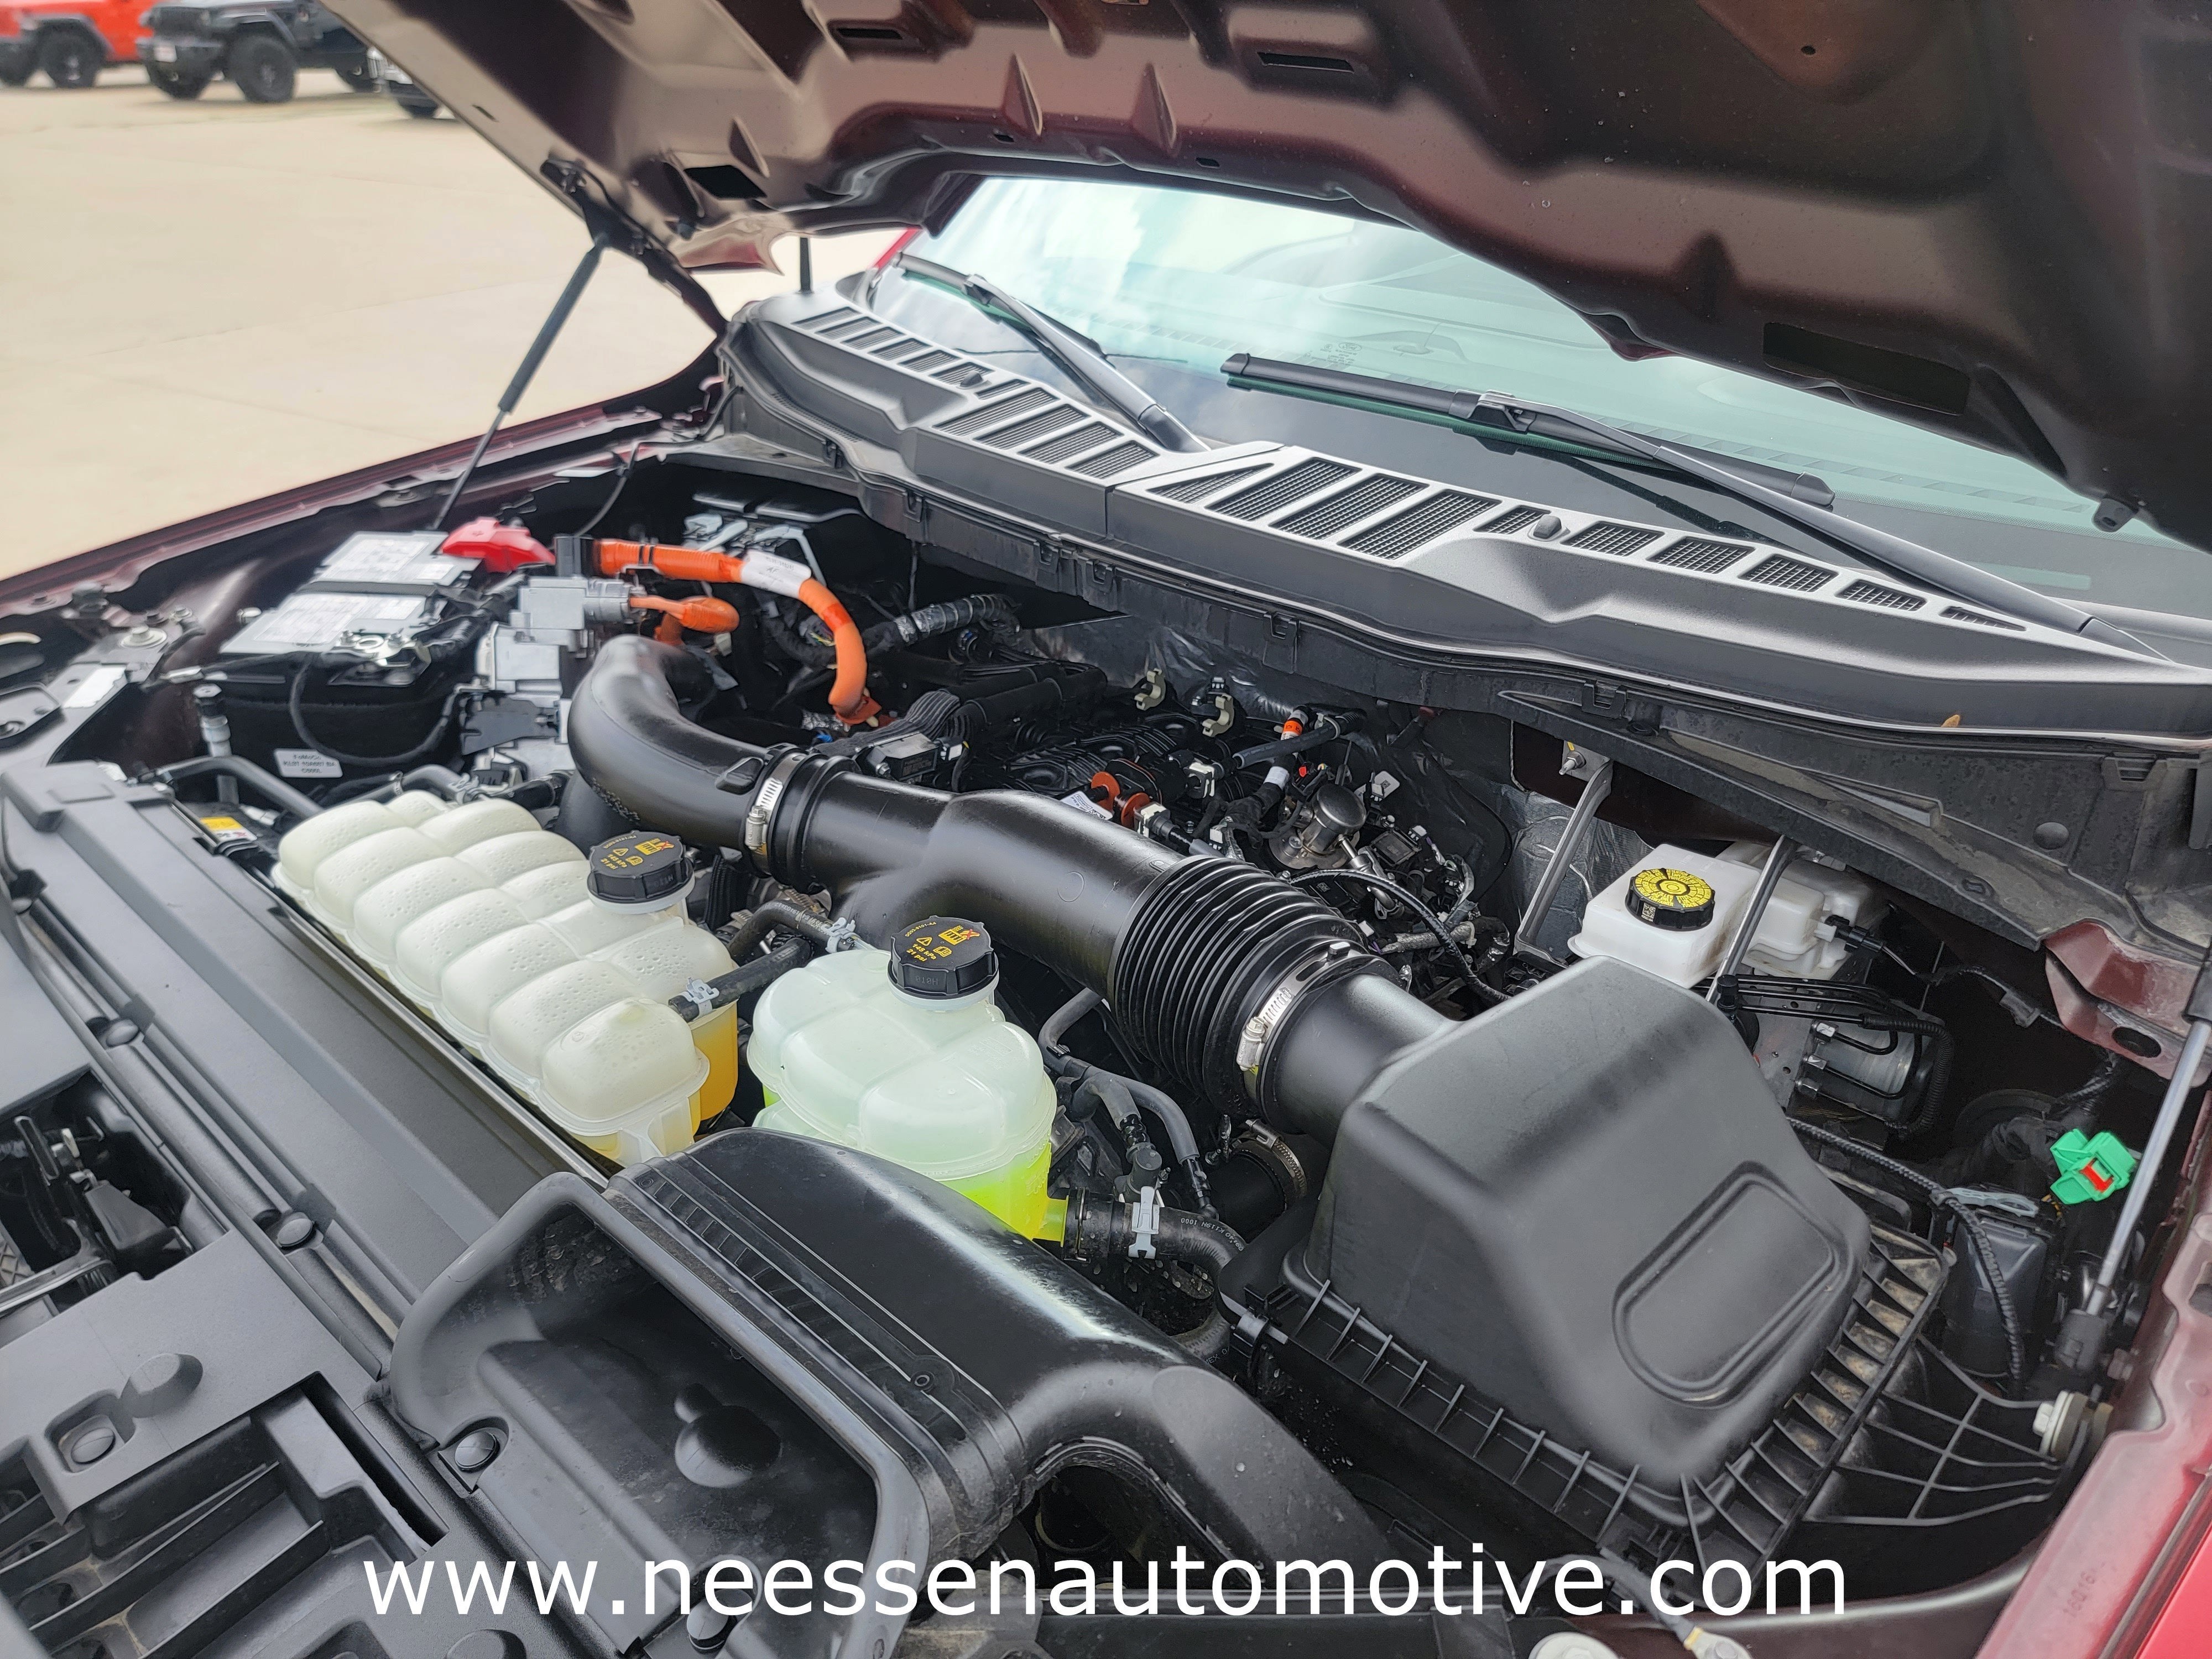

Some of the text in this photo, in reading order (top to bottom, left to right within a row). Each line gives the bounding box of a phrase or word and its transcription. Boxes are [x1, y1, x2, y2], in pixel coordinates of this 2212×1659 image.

[912, 943, 937, 960] 145 kPa
[1180, 1218, 1198, 1226] 1000
